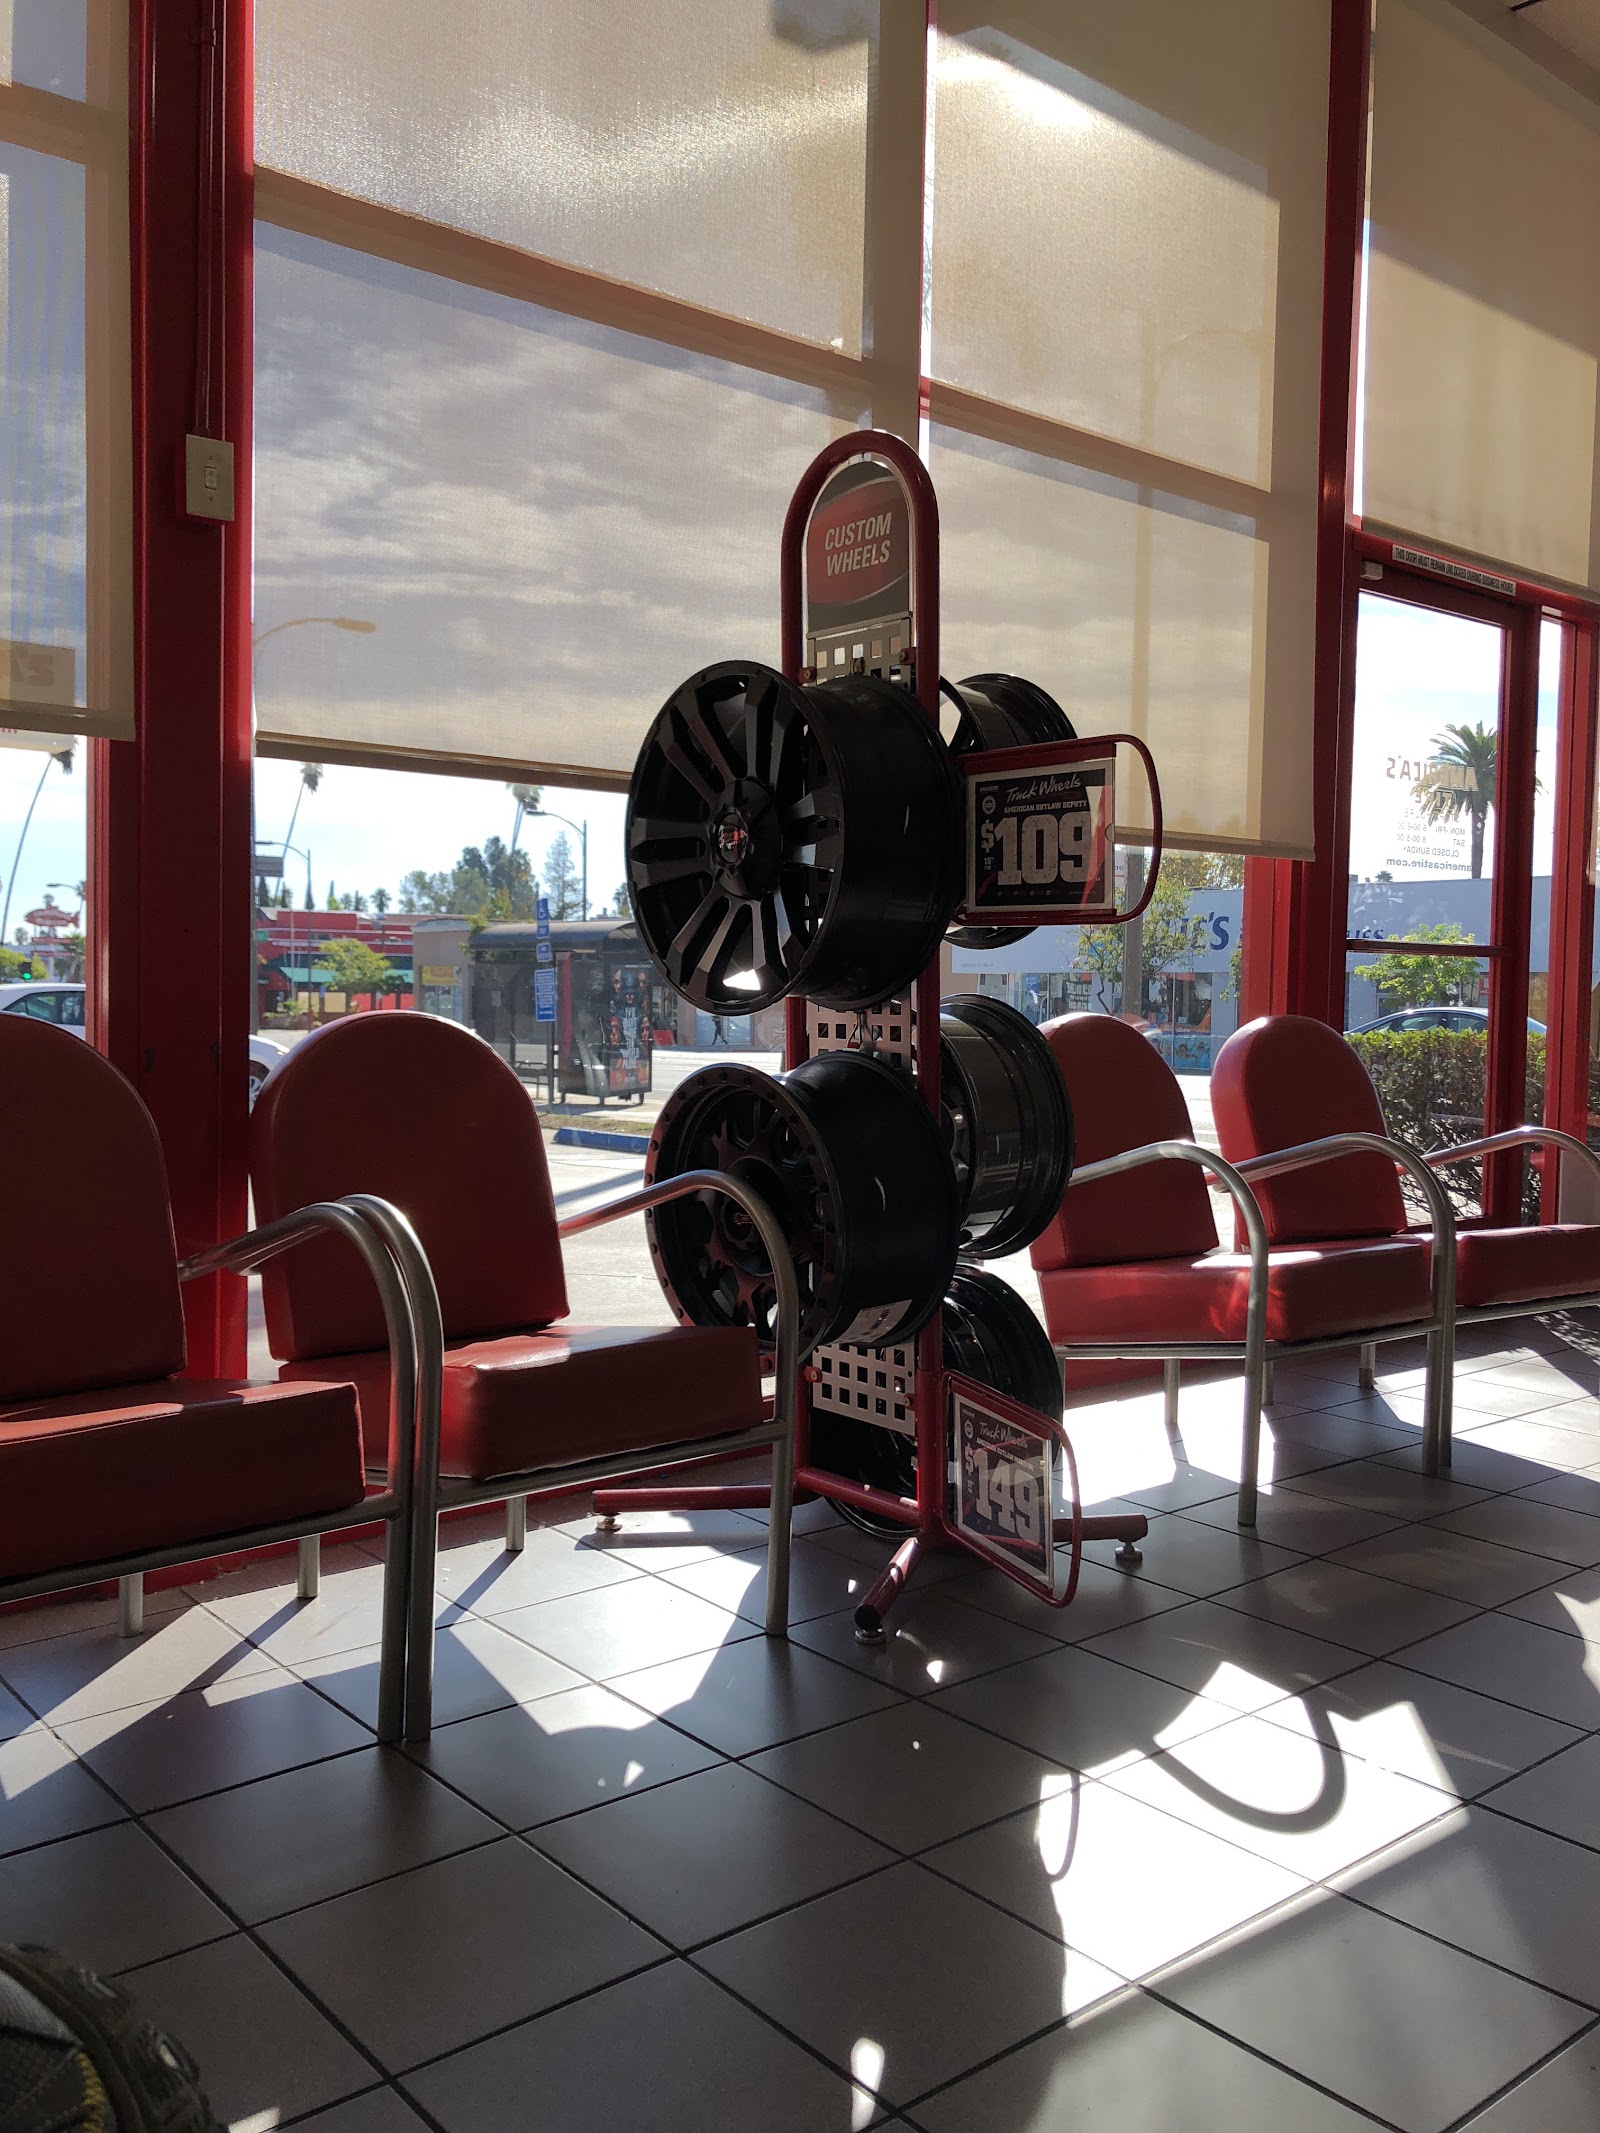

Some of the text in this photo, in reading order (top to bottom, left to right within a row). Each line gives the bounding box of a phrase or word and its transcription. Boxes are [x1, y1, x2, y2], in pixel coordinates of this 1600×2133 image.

[825, 512, 892, 550] CUSTOM
[826, 540, 891, 576] WHEELS
[1405, 551, 1417, 563] DOOR
[1006, 774, 1082, 803] Truck Wheels
[1035, 803, 1062, 811] OUTLAW
[1062, 800, 1088, 808] DEPUTY
[981, 810, 1098, 885] $109
[979, 1422, 1029, 1448] Truck Wheels
[965, 1442, 1040, 1544] $149
